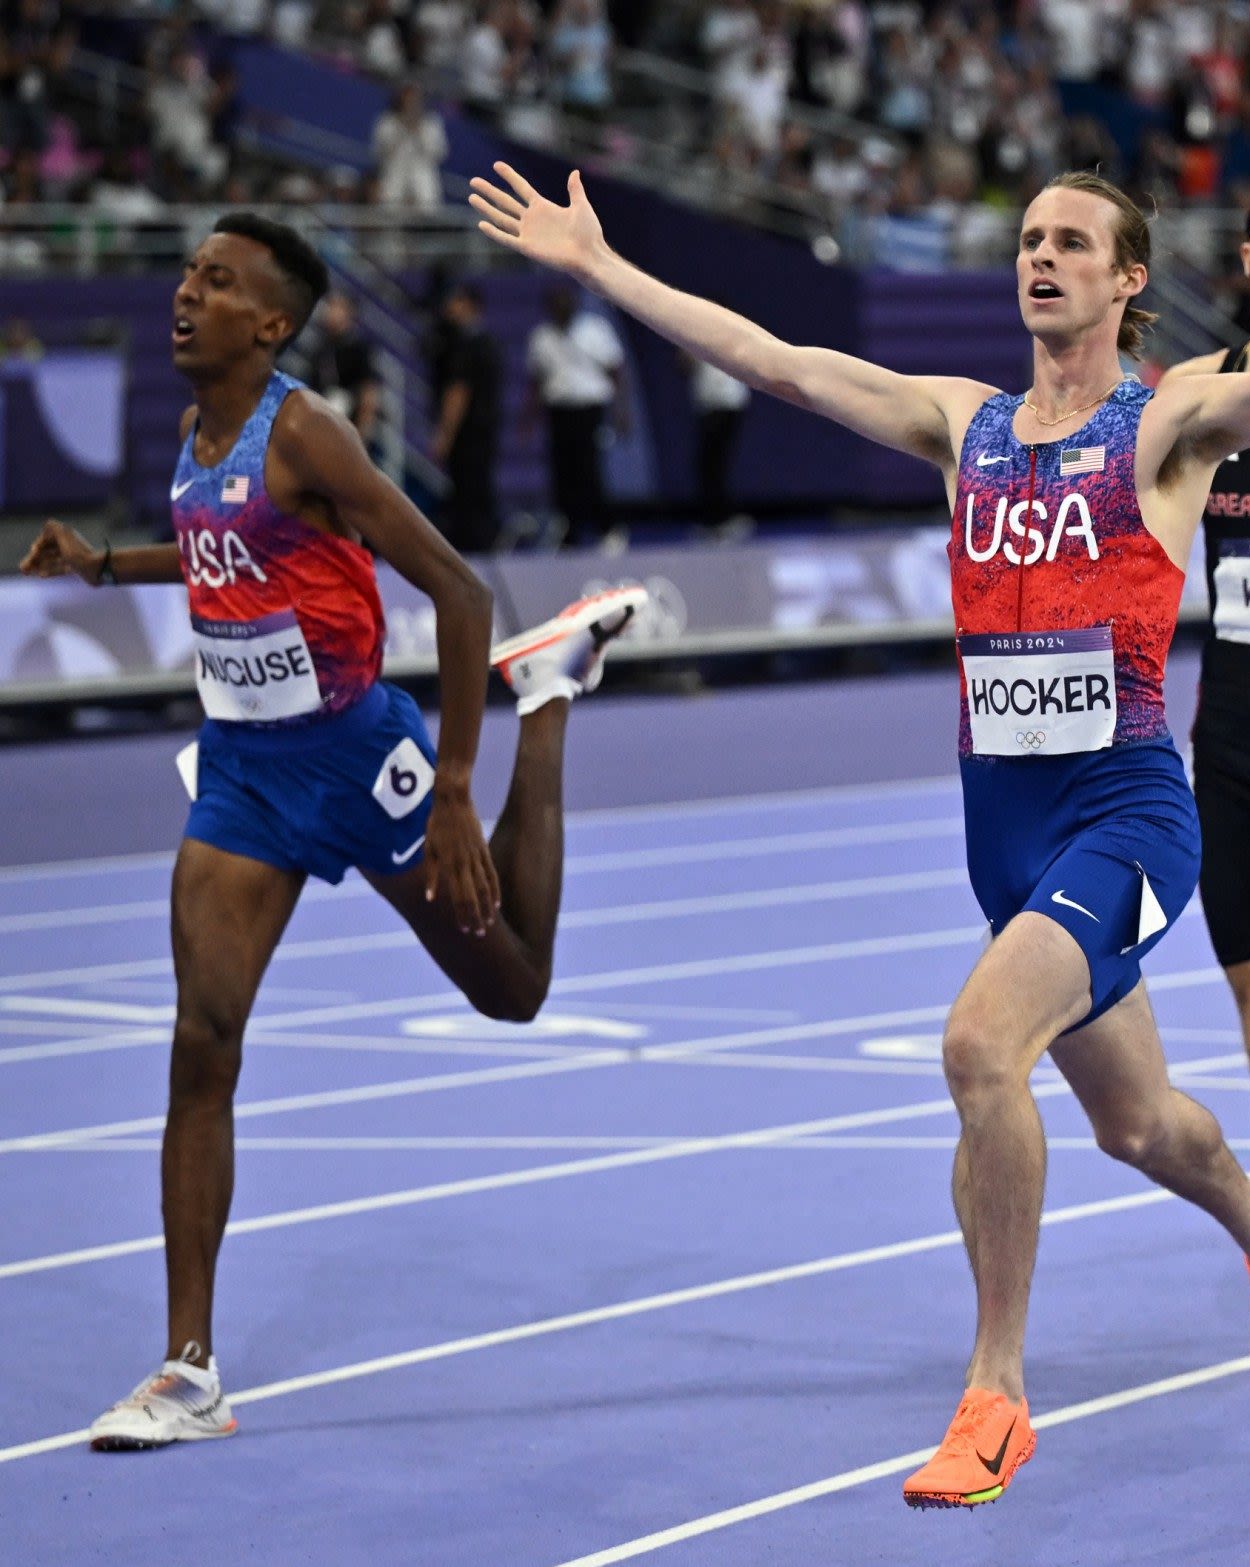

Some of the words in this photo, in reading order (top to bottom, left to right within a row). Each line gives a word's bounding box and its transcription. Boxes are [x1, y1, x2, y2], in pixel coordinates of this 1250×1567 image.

[965, 493, 1099, 565] USA
[178, 529, 268, 588] USA
[989, 639, 1023, 651] PARIS
[1026, 637, 1065, 650] 2024
[199, 645, 310, 687] NUGUSE
[971, 674, 1112, 717] HOCKER
[389, 764, 418, 797] 6
